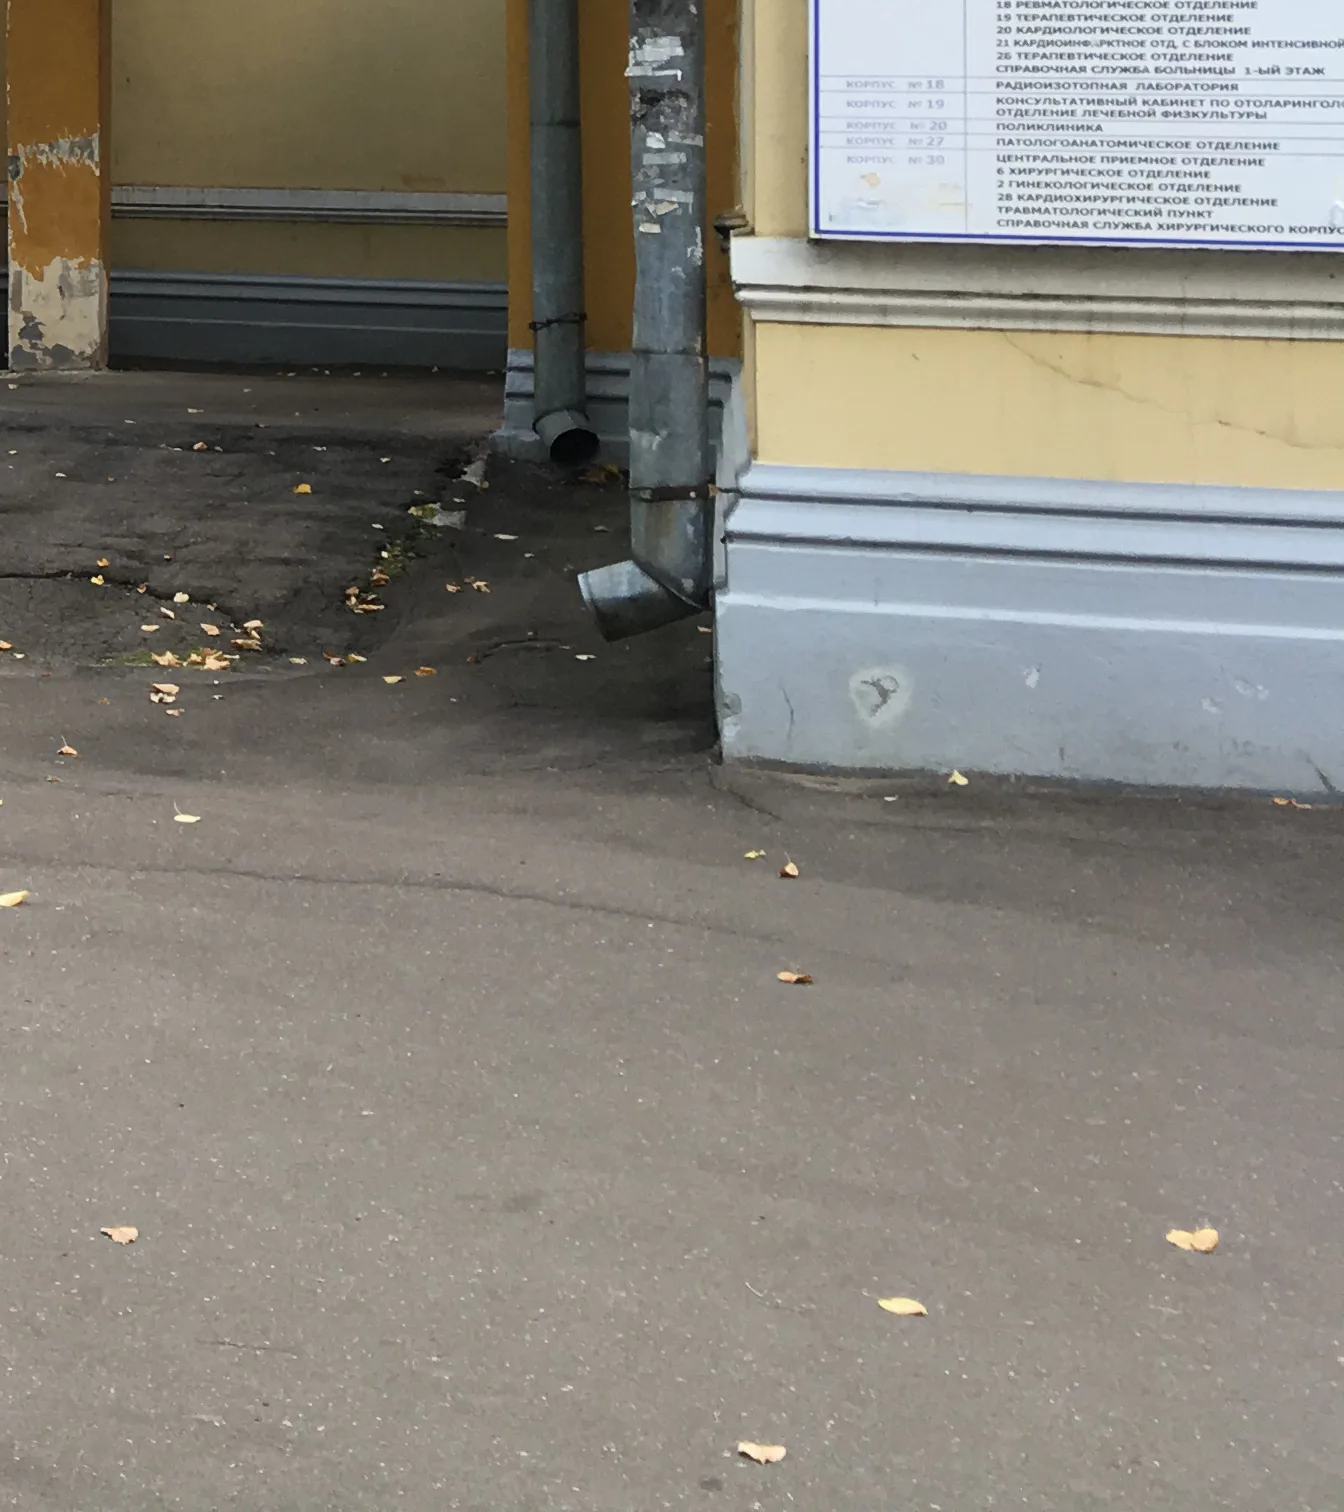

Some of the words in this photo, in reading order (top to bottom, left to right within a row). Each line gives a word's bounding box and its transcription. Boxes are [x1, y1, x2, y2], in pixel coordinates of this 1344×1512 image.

[996, 0, 1011, 8] 18
[1015, 0, 1169, 9] РЕВМАТОЛОГИЧЕСКОЕ
[1174, 0, 1258, 10] ОТДЕЛЕНИЕ
[996, 13, 1011, 22] 19
[1015, 13, 1146, 22] ТЕРАПЕВТИЧЕСКОЕ
[1150, 13, 1234, 23] ОТДЕЛЕНИЕ
[996, 26, 1012, 34] 20
[1015, 26, 1163, 36] КАРДИОЛОГИЧЕСКОЕ
[1167, 26, 1250, 36] ОТДЕЛЕНИЕ
[996, 39, 1009, 48] 21
[1181, 39, 1190, 48] С
[1193, 39, 1248, 49] БЛОКОМ
[1015, 52, 1146, 61] ТЕРАПЕВТИЧЕСКОЕ
[1150, 52, 1233, 62] ОТДЕЛЕНИЕ
[995, 64, 1087, 73] СПРАВОЧНАЯ
[1090, 65, 1150, 74] СЛУЖБА
[1153, 65, 1235, 76] БОЛЬНИЦЫ
[1245, 64, 1280, 75] 1-ЫЙ
[1285, 66, 1325, 75] ЭТАЖ
[995, 81, 1127, 91] РАДИОИЗОТОПНАЯ
[1135, 82, 1239, 91] ЛАБОРАТОРИЯ
[996, 94, 1137, 106] КОНСУЛЬТАТИВНЫЙ
[1141, 98, 1205, 107] КАБИНЕТ
[1209, 98, 1230, 107] ПО
[995, 108, 1077, 118] ОТДЕЛЕНИЕ
[1080, 107, 1156, 118] ЛЕЧЕБНОЙ
[1160, 109, 1267, 119] ФИЗКУЛЬТУРЫ
[996, 123, 1103, 131] ПОЛИКЛИНИКА
[996, 138, 1191, 149] ПАТОЛОГОАНАТОМИЧЕСКОЕ
[1196, 140, 1279, 151] ОТДЕЛЕНИЕ
[996, 154, 1096, 165] ЦЕНТРАЛЬНОЕ
[1100, 155, 1177, 165] ПРИЕМНОЕ
[1180, 156, 1265, 167] ОТДЕЛЕНИЕ
[996, 167, 1004, 175] 6
[1008, 167, 1123, 177] ХИРУРГИЧЕСКОЕ
[1127, 169, 1210, 180] ОТДЕЛЕНИЕ
[997, 180, 1004, 188] 2
[1008, 180, 1154, 191] ГИНЕКОЛОГИЧЕСКОЕ
[1157, 182, 1241, 194] ОТДЕЛЕНИЕ
[997, 193, 1013, 201] 28
[1016, 193, 1190, 206] КАРДИОХИРУРГИЧЕСКОЕ
[1193, 196, 1277, 208] ОТДЕЛЕНИЕ
[997, 203, 1163, 217] ТРАВМАТОЛОГИЧЕСКИЙ
[1166, 209, 1213, 218] ПУНКТ
[996, 219, 1089, 229] СПРАВОЧНАЯ
[1092, 221, 1152, 230] СЛУЖБА
[1157, 222, 1284, 233] ХИРУРГИЧЕСКОГО
